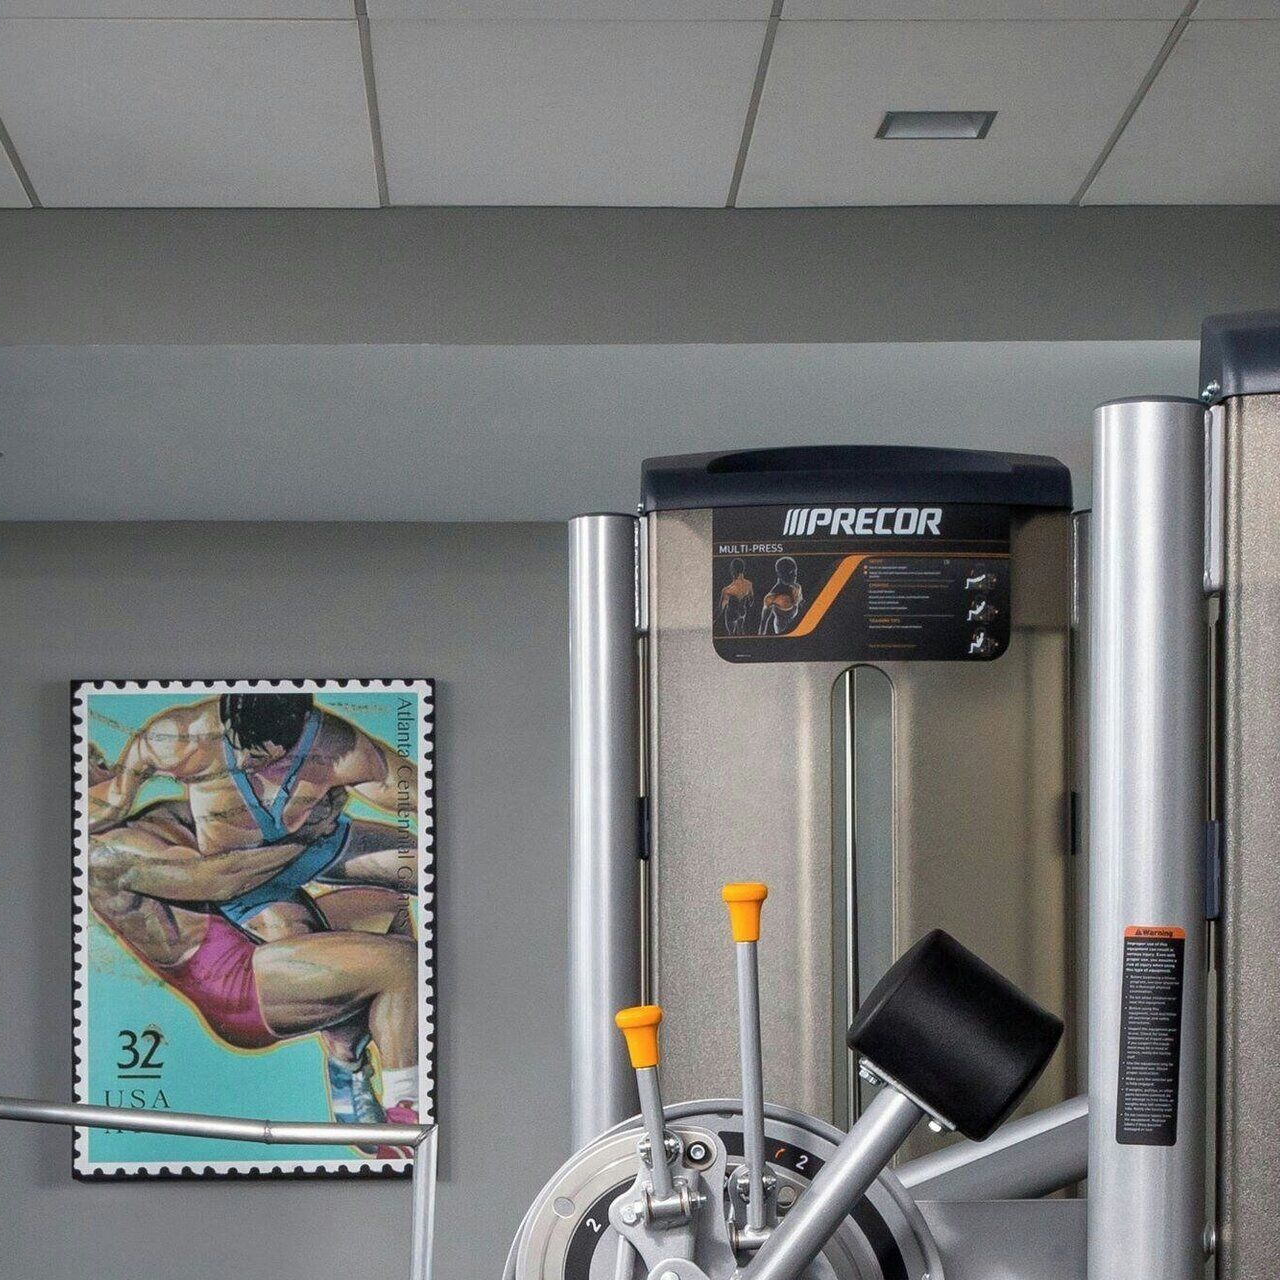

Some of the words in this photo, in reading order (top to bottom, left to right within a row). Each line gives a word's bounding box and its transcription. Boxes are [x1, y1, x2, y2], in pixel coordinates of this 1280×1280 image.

[806, 508, 942, 535] PRECOR
[719, 543, 783, 554] MULTI-PRESS
[397, 697, 415, 760] Atlanta
[397, 765, 415, 859] Centennial
[116, 1029, 164, 1069] 32
[105, 1089, 170, 1109] USA
[795, 1154, 809, 1170] 2
[585, 1217, 602, 1233] 2
